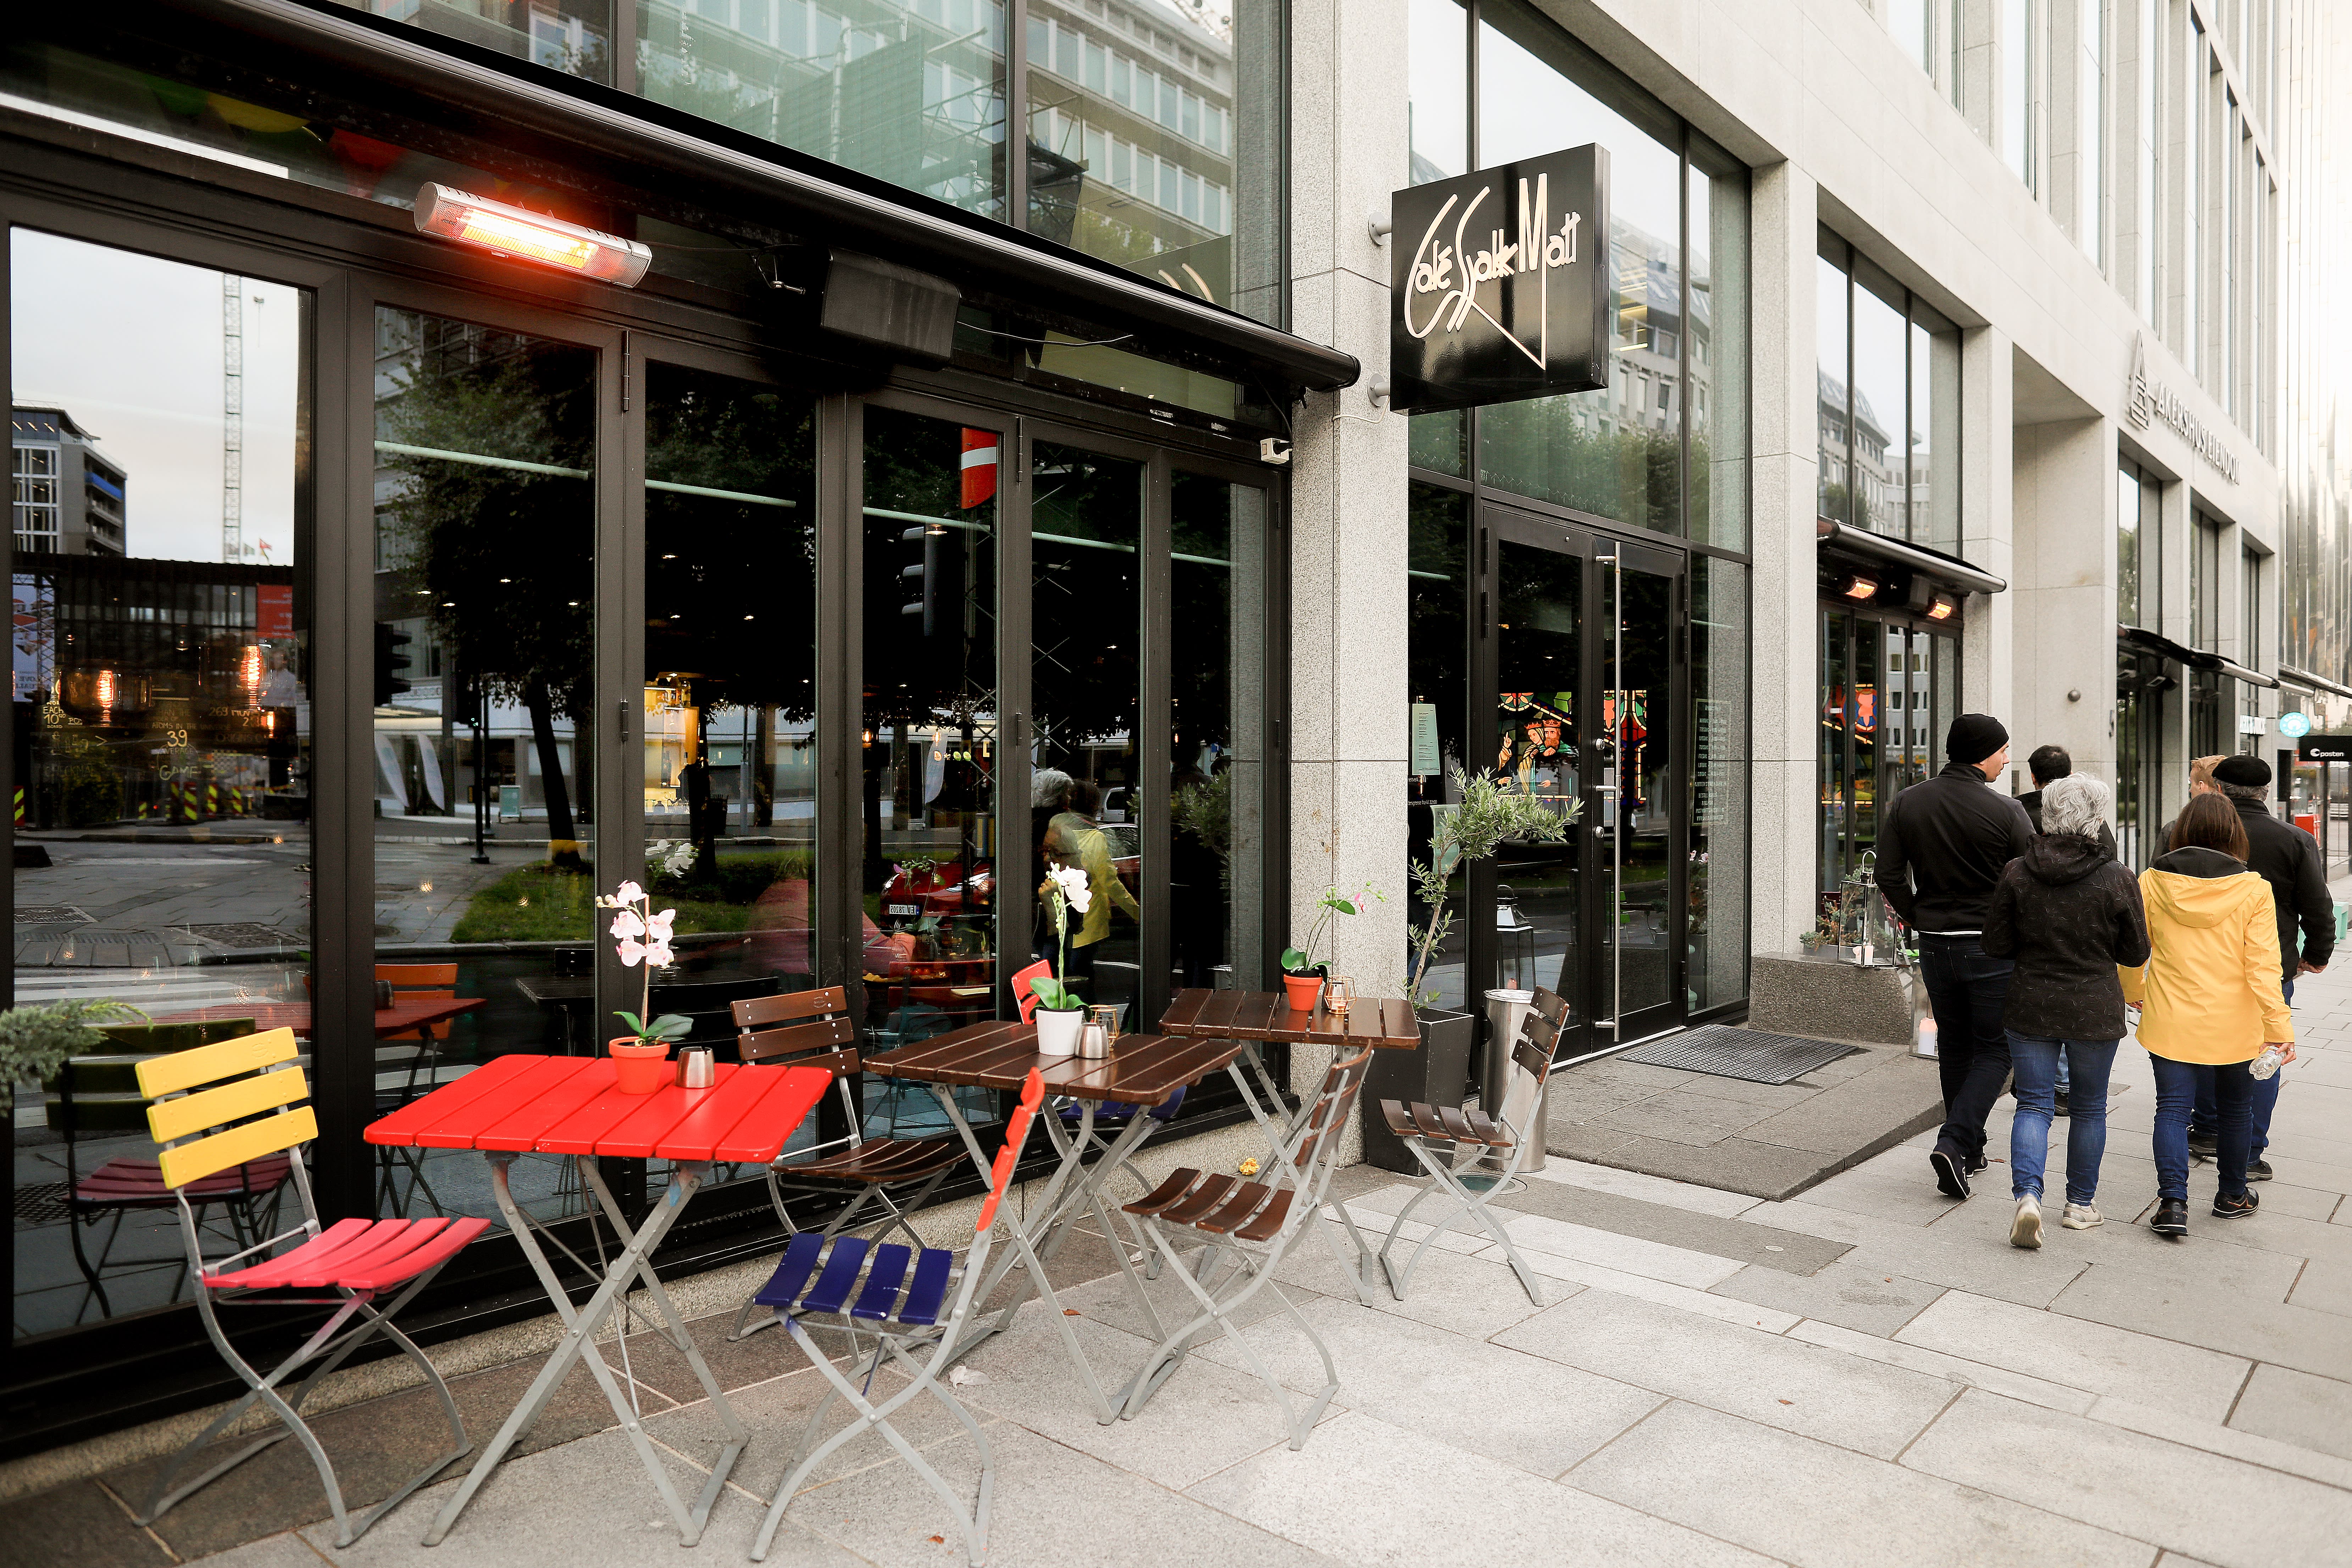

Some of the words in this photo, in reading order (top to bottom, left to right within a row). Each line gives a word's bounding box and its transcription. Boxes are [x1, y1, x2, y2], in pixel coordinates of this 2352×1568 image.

[1519, 172, 1581, 370] Matt
[2158, 382, 2206, 453] AKERSHUS
[2208, 430, 2240, 486] EIENDOM
[167, 729, 188, 747] 39
